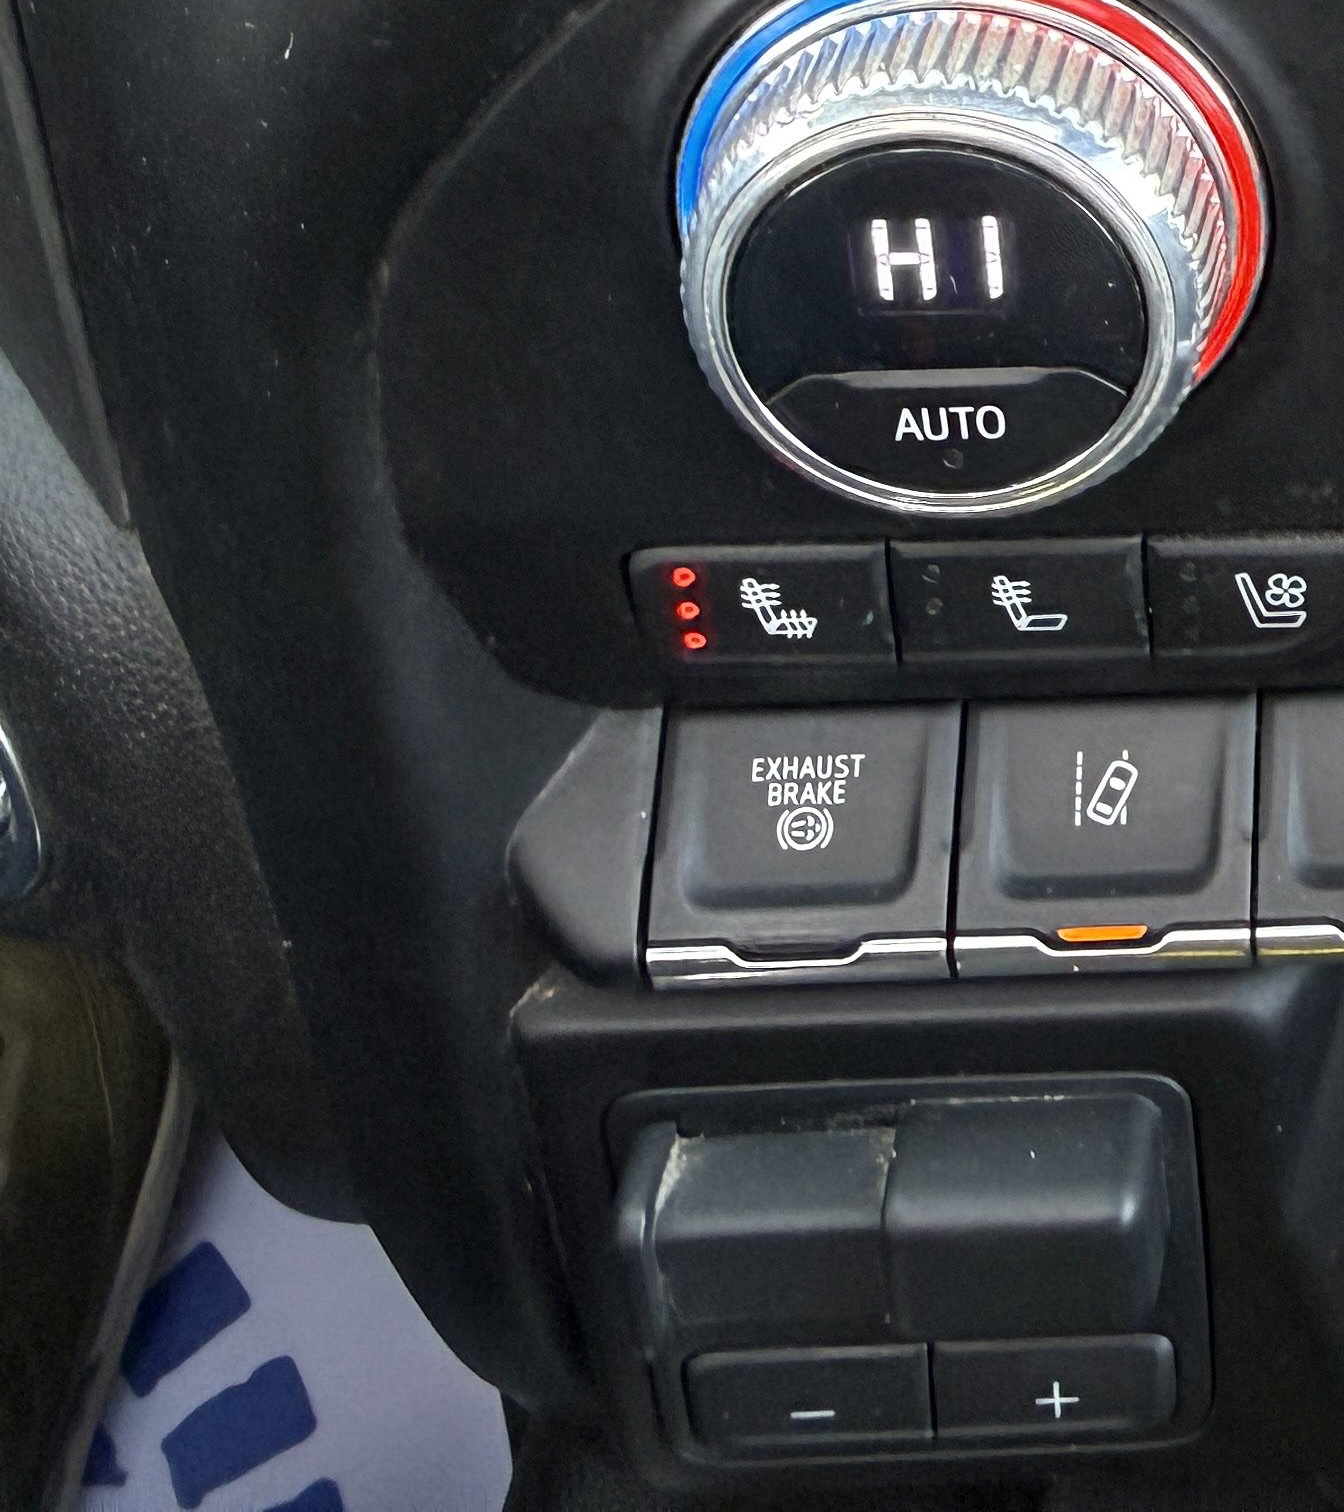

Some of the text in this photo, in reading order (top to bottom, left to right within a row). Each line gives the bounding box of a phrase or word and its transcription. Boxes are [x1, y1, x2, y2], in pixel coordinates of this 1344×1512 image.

[871, 215, 1004, 301] HI
[894, 405, 1006, 442] AUTO
[751, 753, 866, 782] EXHAUST
[767, 779, 846, 807] BRAKE
